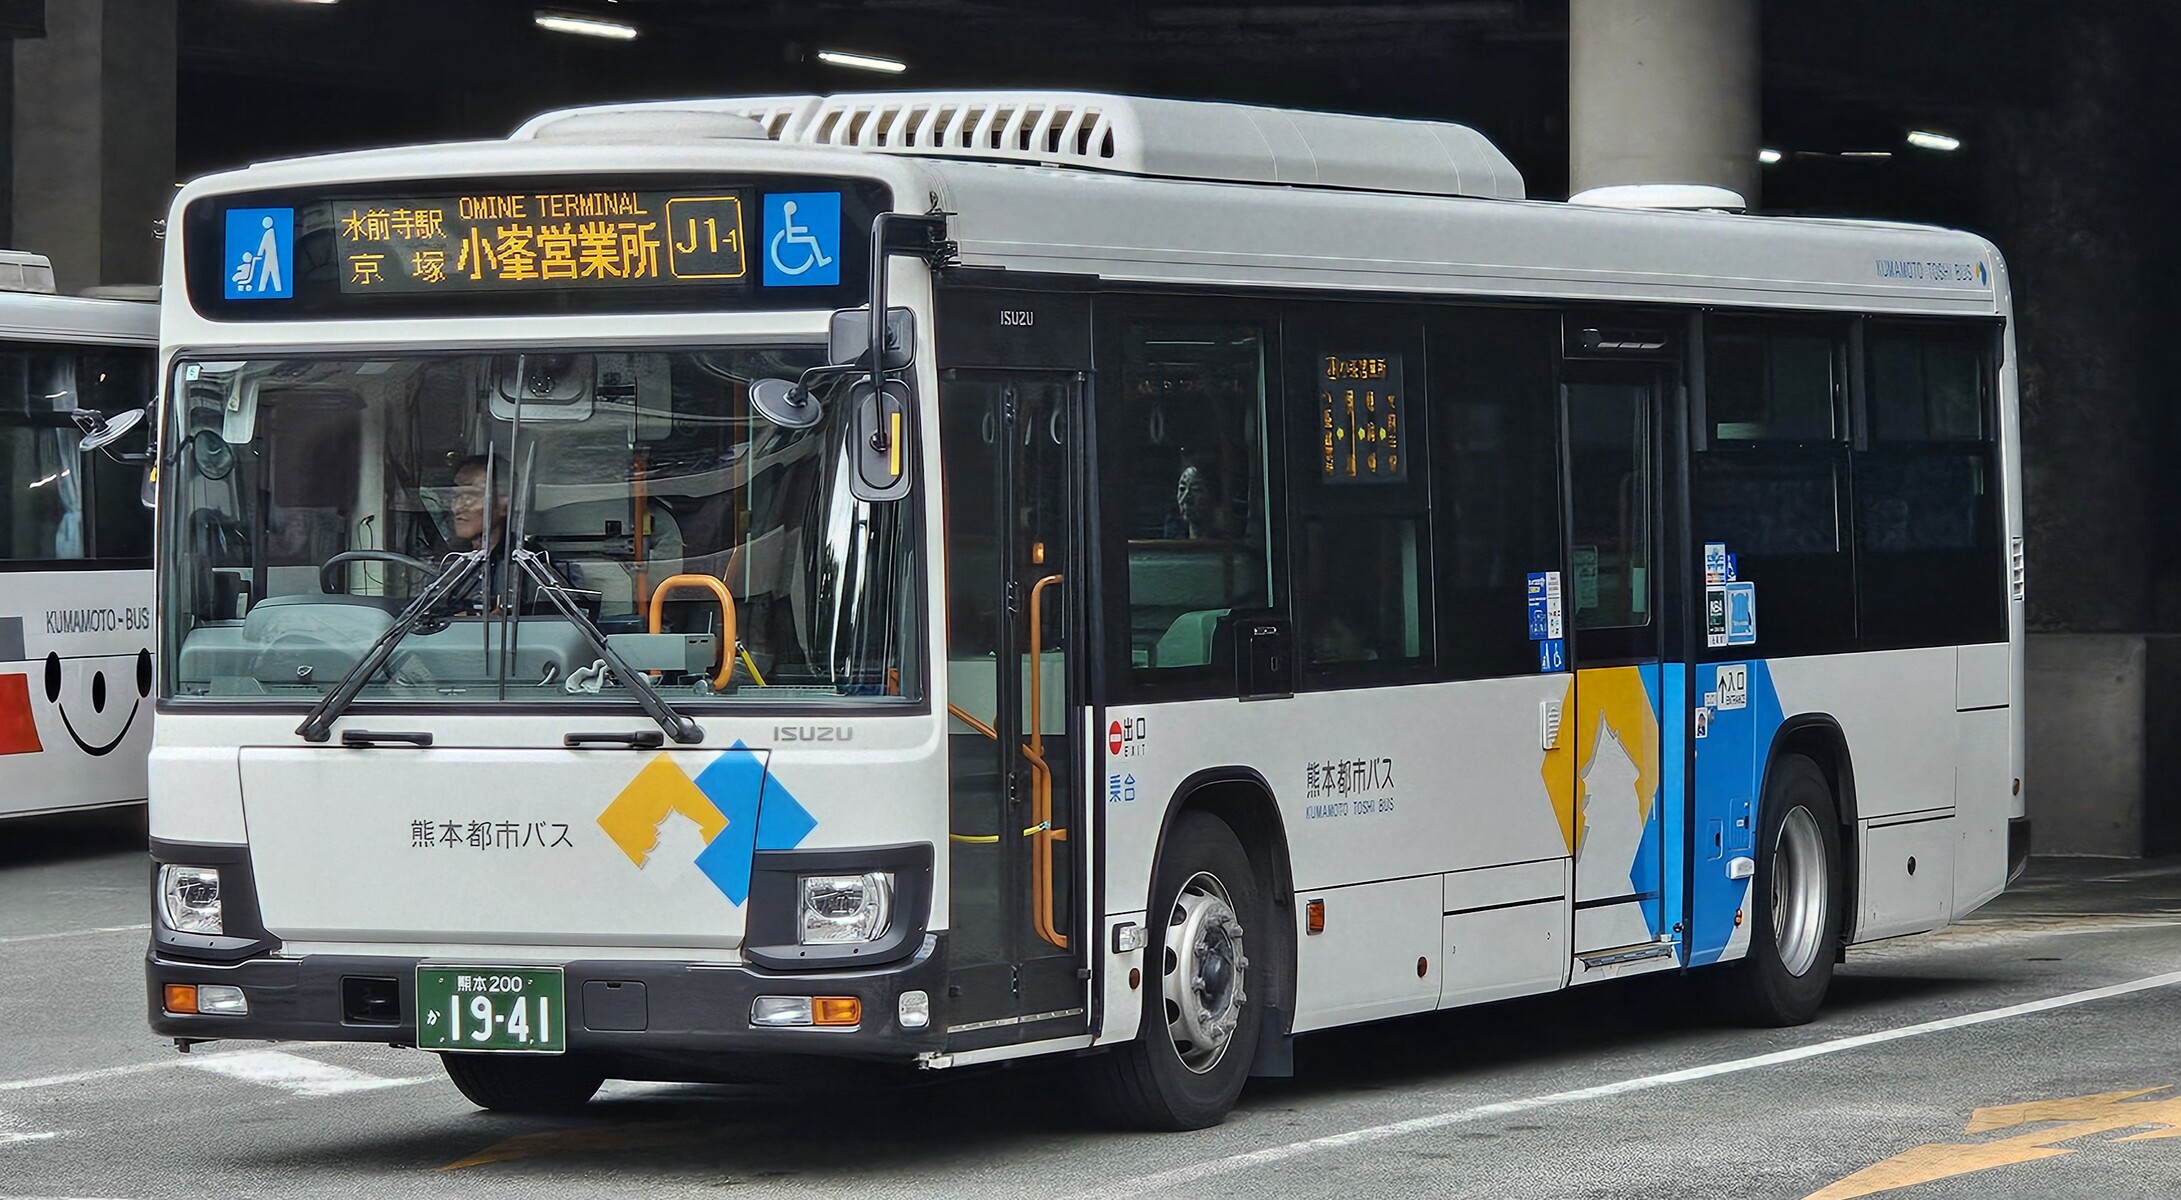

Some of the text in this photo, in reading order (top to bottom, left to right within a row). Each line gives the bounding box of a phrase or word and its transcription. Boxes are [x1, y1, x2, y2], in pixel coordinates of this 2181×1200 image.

[459, 192, 648, 220] OMINE TERMINAL
[341, 208, 447, 241] 水前寺駅
[457, 221, 660, 280] 小峯営業所
[348, 253, 385, 284] 京
[1000, 310, 1034, 326] ISUZU
[1727, 671, 1745, 692] 入口
[773, 726, 853, 741] ISUZU
[1123, 717, 1146, 741] 出口
[1124, 744, 1146, 757] EXIT
[1306, 757, 1395, 799] 熊本都市バス
[1305, 802, 1349, 819] KUMAMOTO
[411, 819, 574, 851] 熊本都市バス
[426, 1009, 441, 1026] か
[451, 995, 549, 1043] 19-41
